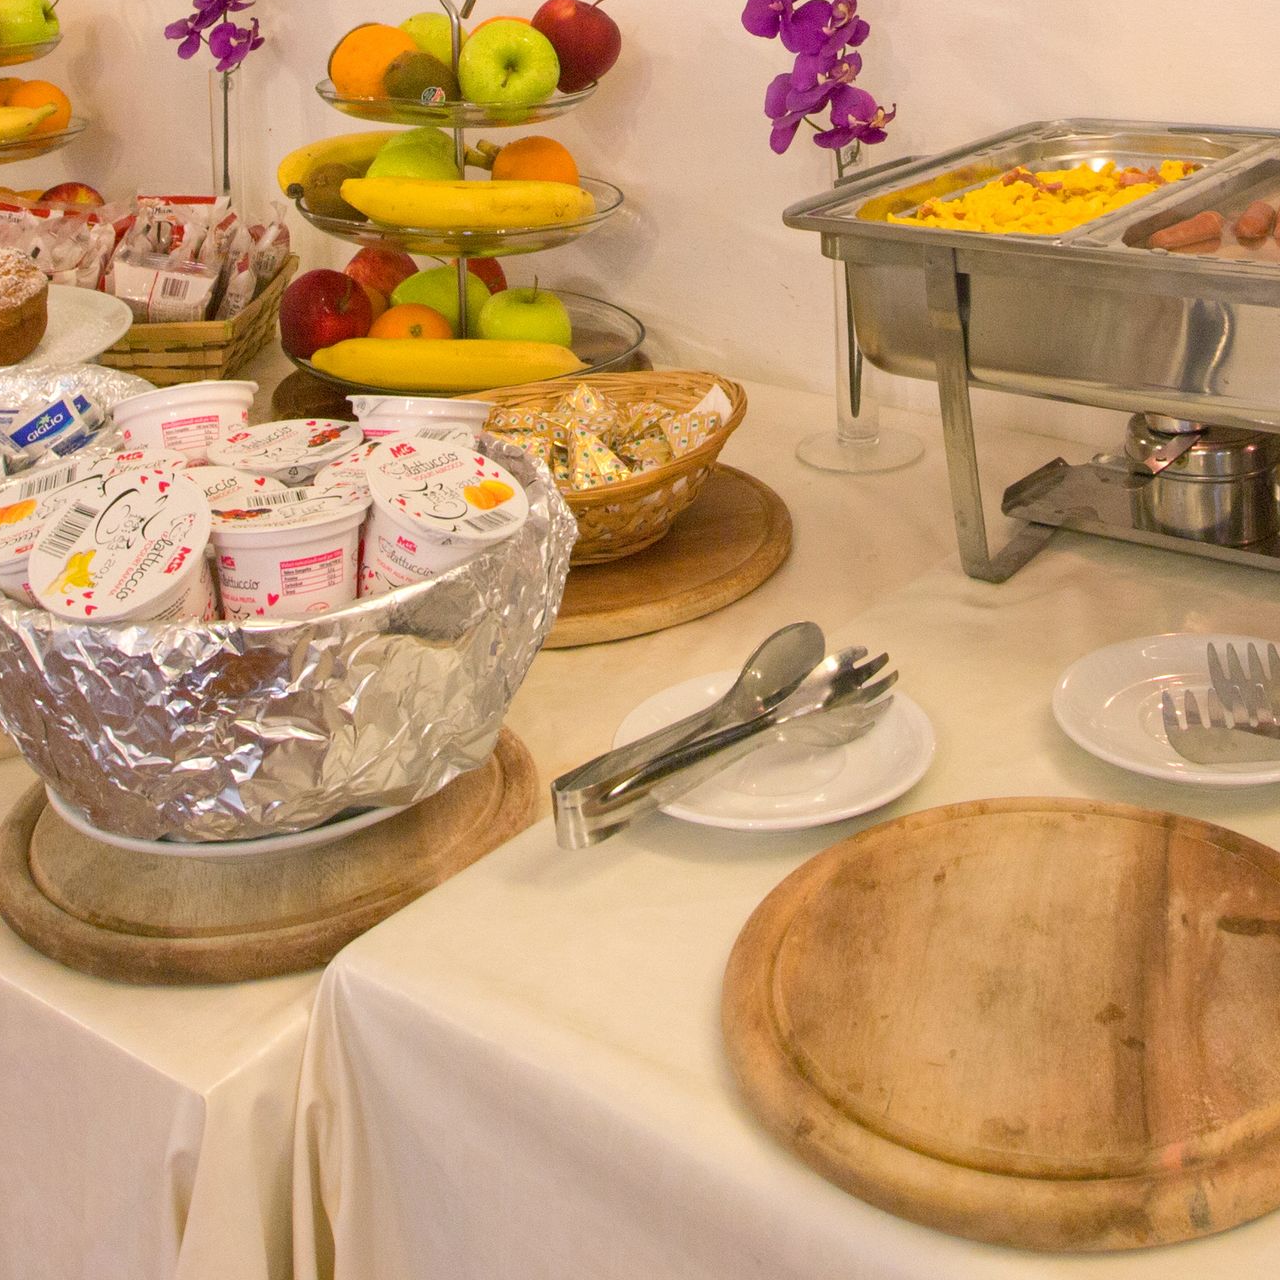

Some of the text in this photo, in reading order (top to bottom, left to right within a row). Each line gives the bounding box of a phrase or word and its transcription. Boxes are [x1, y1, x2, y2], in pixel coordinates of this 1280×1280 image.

[27, 412, 63, 443] GIGLIO
[389, 442, 417, 459] MG
[402, 451, 459, 476] lattuccio
[133, 538, 156, 567] YOGURT
[163, 546, 192, 574] MG
[115, 537, 174, 601] lattuccio
